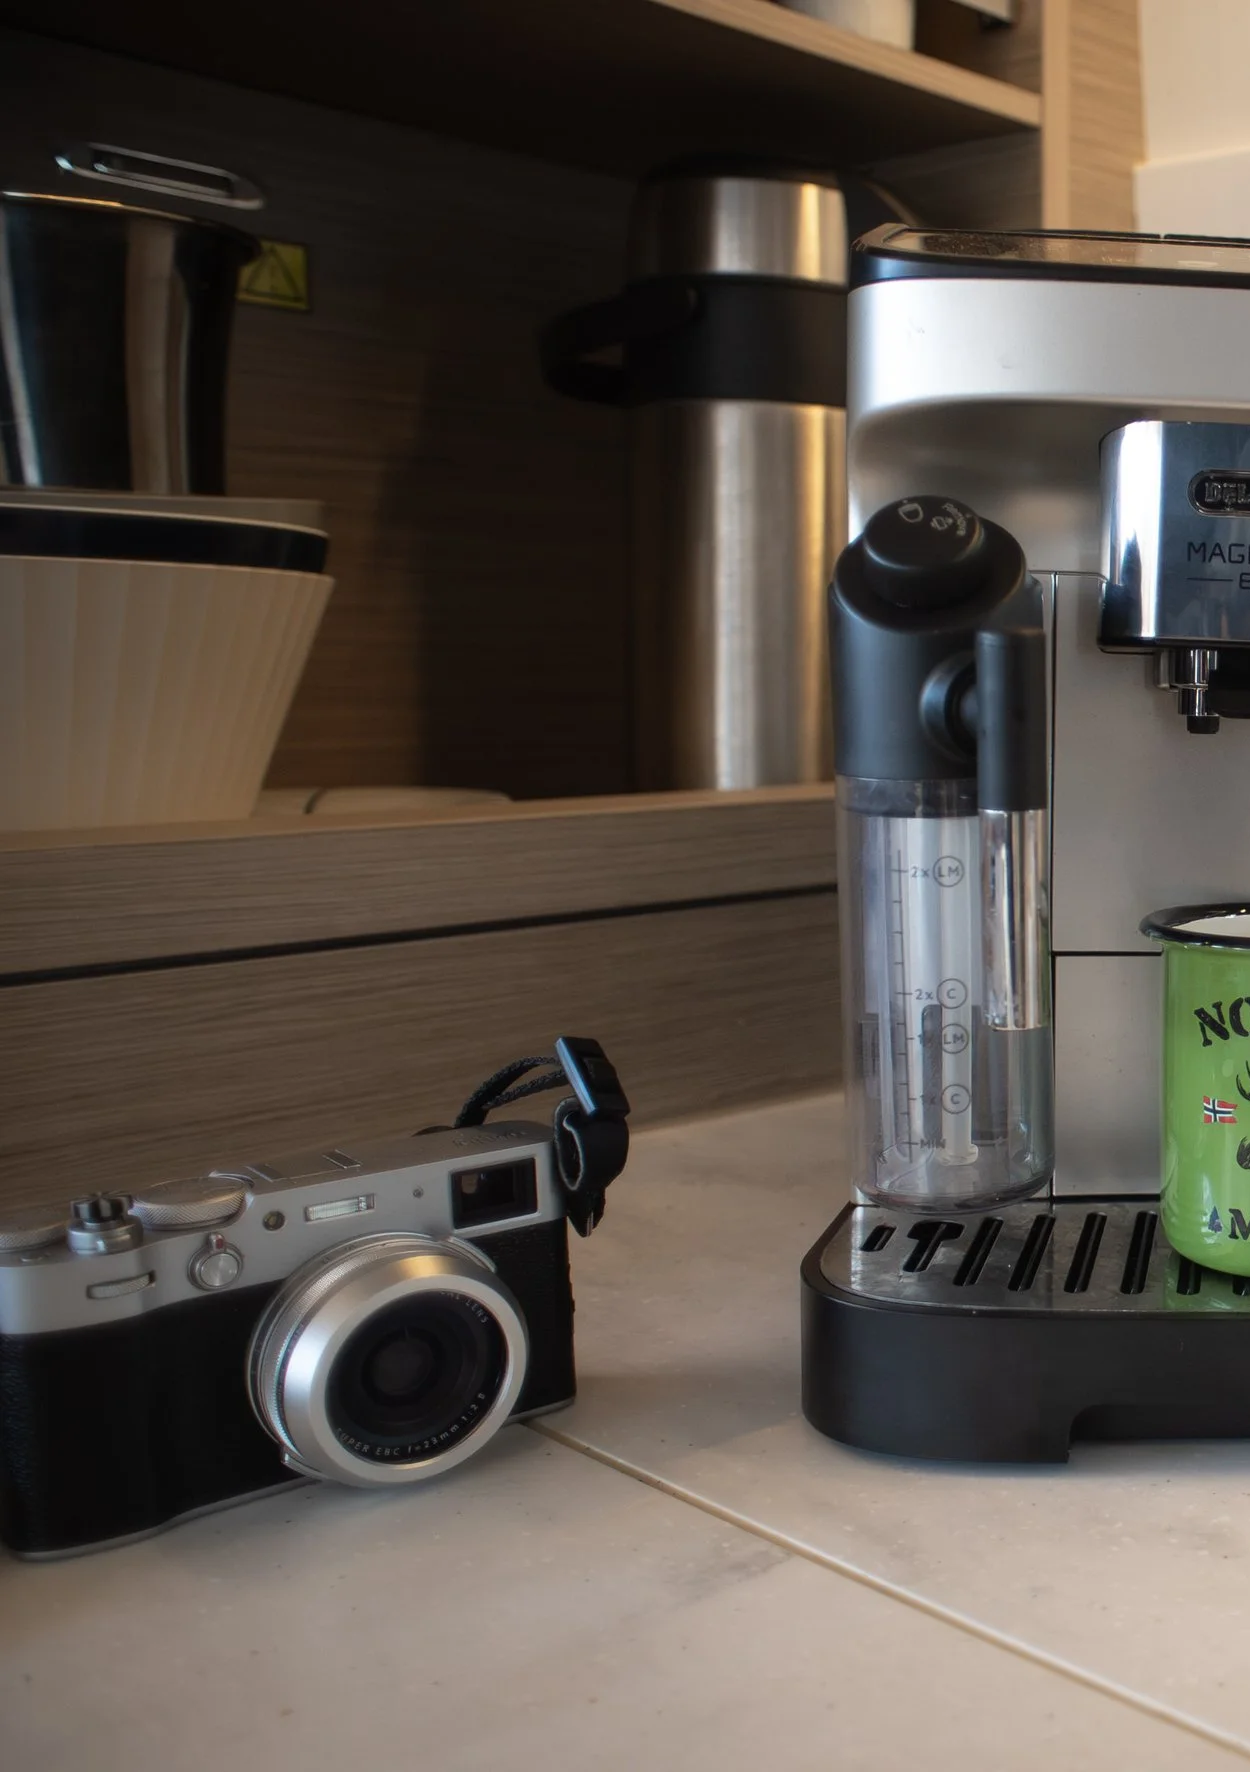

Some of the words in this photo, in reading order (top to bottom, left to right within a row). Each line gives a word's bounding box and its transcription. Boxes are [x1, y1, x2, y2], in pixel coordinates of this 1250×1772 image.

[915, 988, 933, 1000] 2x
[920, 1138, 946, 1149] MIN
[375, 1446, 401, 1456] EBC
